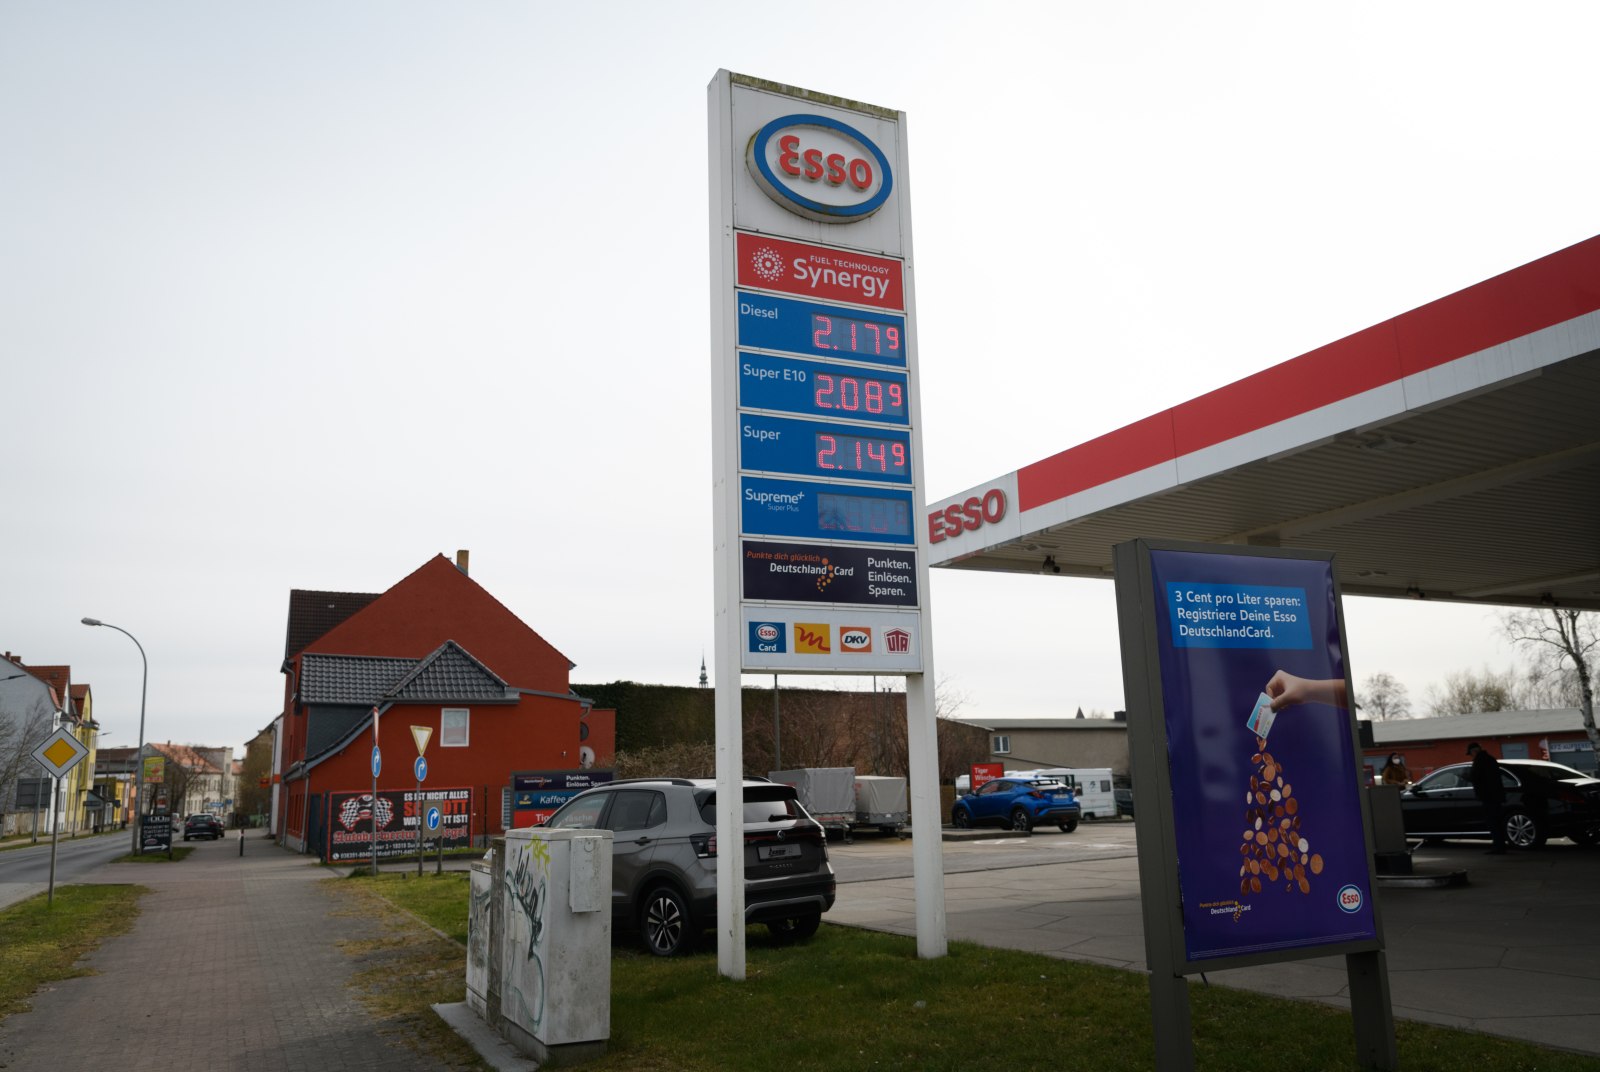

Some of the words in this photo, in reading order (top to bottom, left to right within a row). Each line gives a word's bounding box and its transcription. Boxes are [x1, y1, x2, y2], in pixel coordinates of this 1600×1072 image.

[809, 255, 831, 265] FUEL
[833, 259, 890, 275] TECHNOLOGY
[793, 258, 890, 299] Synergy
[740, 303, 779, 320] Diesel
[743, 364, 781, 381] Super
[783, 369, 806, 382] E10
[743, 425, 781, 442] Super
[767, 503, 786, 512] Super
[786, 504, 799, 513] Plus
[928, 488, 1007, 544] ESSO
[746, 550, 773, 560] Punkte
[774, 552, 789, 561] dich
[790, 552, 821, 564] glücklich
[867, 557, 912, 570] Punkten.
[769, 562, 827, 575] Deutschland
[834, 566, 854, 577] Card
[868, 571, 912, 584] Einlösen.
[868, 585, 906, 598] Sparen.
[1174, 590, 1183, 602] 3
[1186, 590, 1212, 603] Cent
[1215, 594, 1234, 607] pro
[1237, 593, 1261, 605] Liter
[1264, 597, 1301, 608] sparen:
[1177, 607, 1237, 623] Registriere
[1239, 610, 1271, 622] Deine
[1273, 611, 1297, 622] Esso
[1179, 624, 1275, 638] DeutschlandCard.
[844, 635, 868, 644] DKV
[885, 630, 910, 652] UTA
[758, 643, 777, 652] Card
[404, 793, 413, 801] ES
[426, 791, 448, 800] NICHT
[448, 790, 469, 799] ALLES
[540, 795, 566, 805] Kaffee
